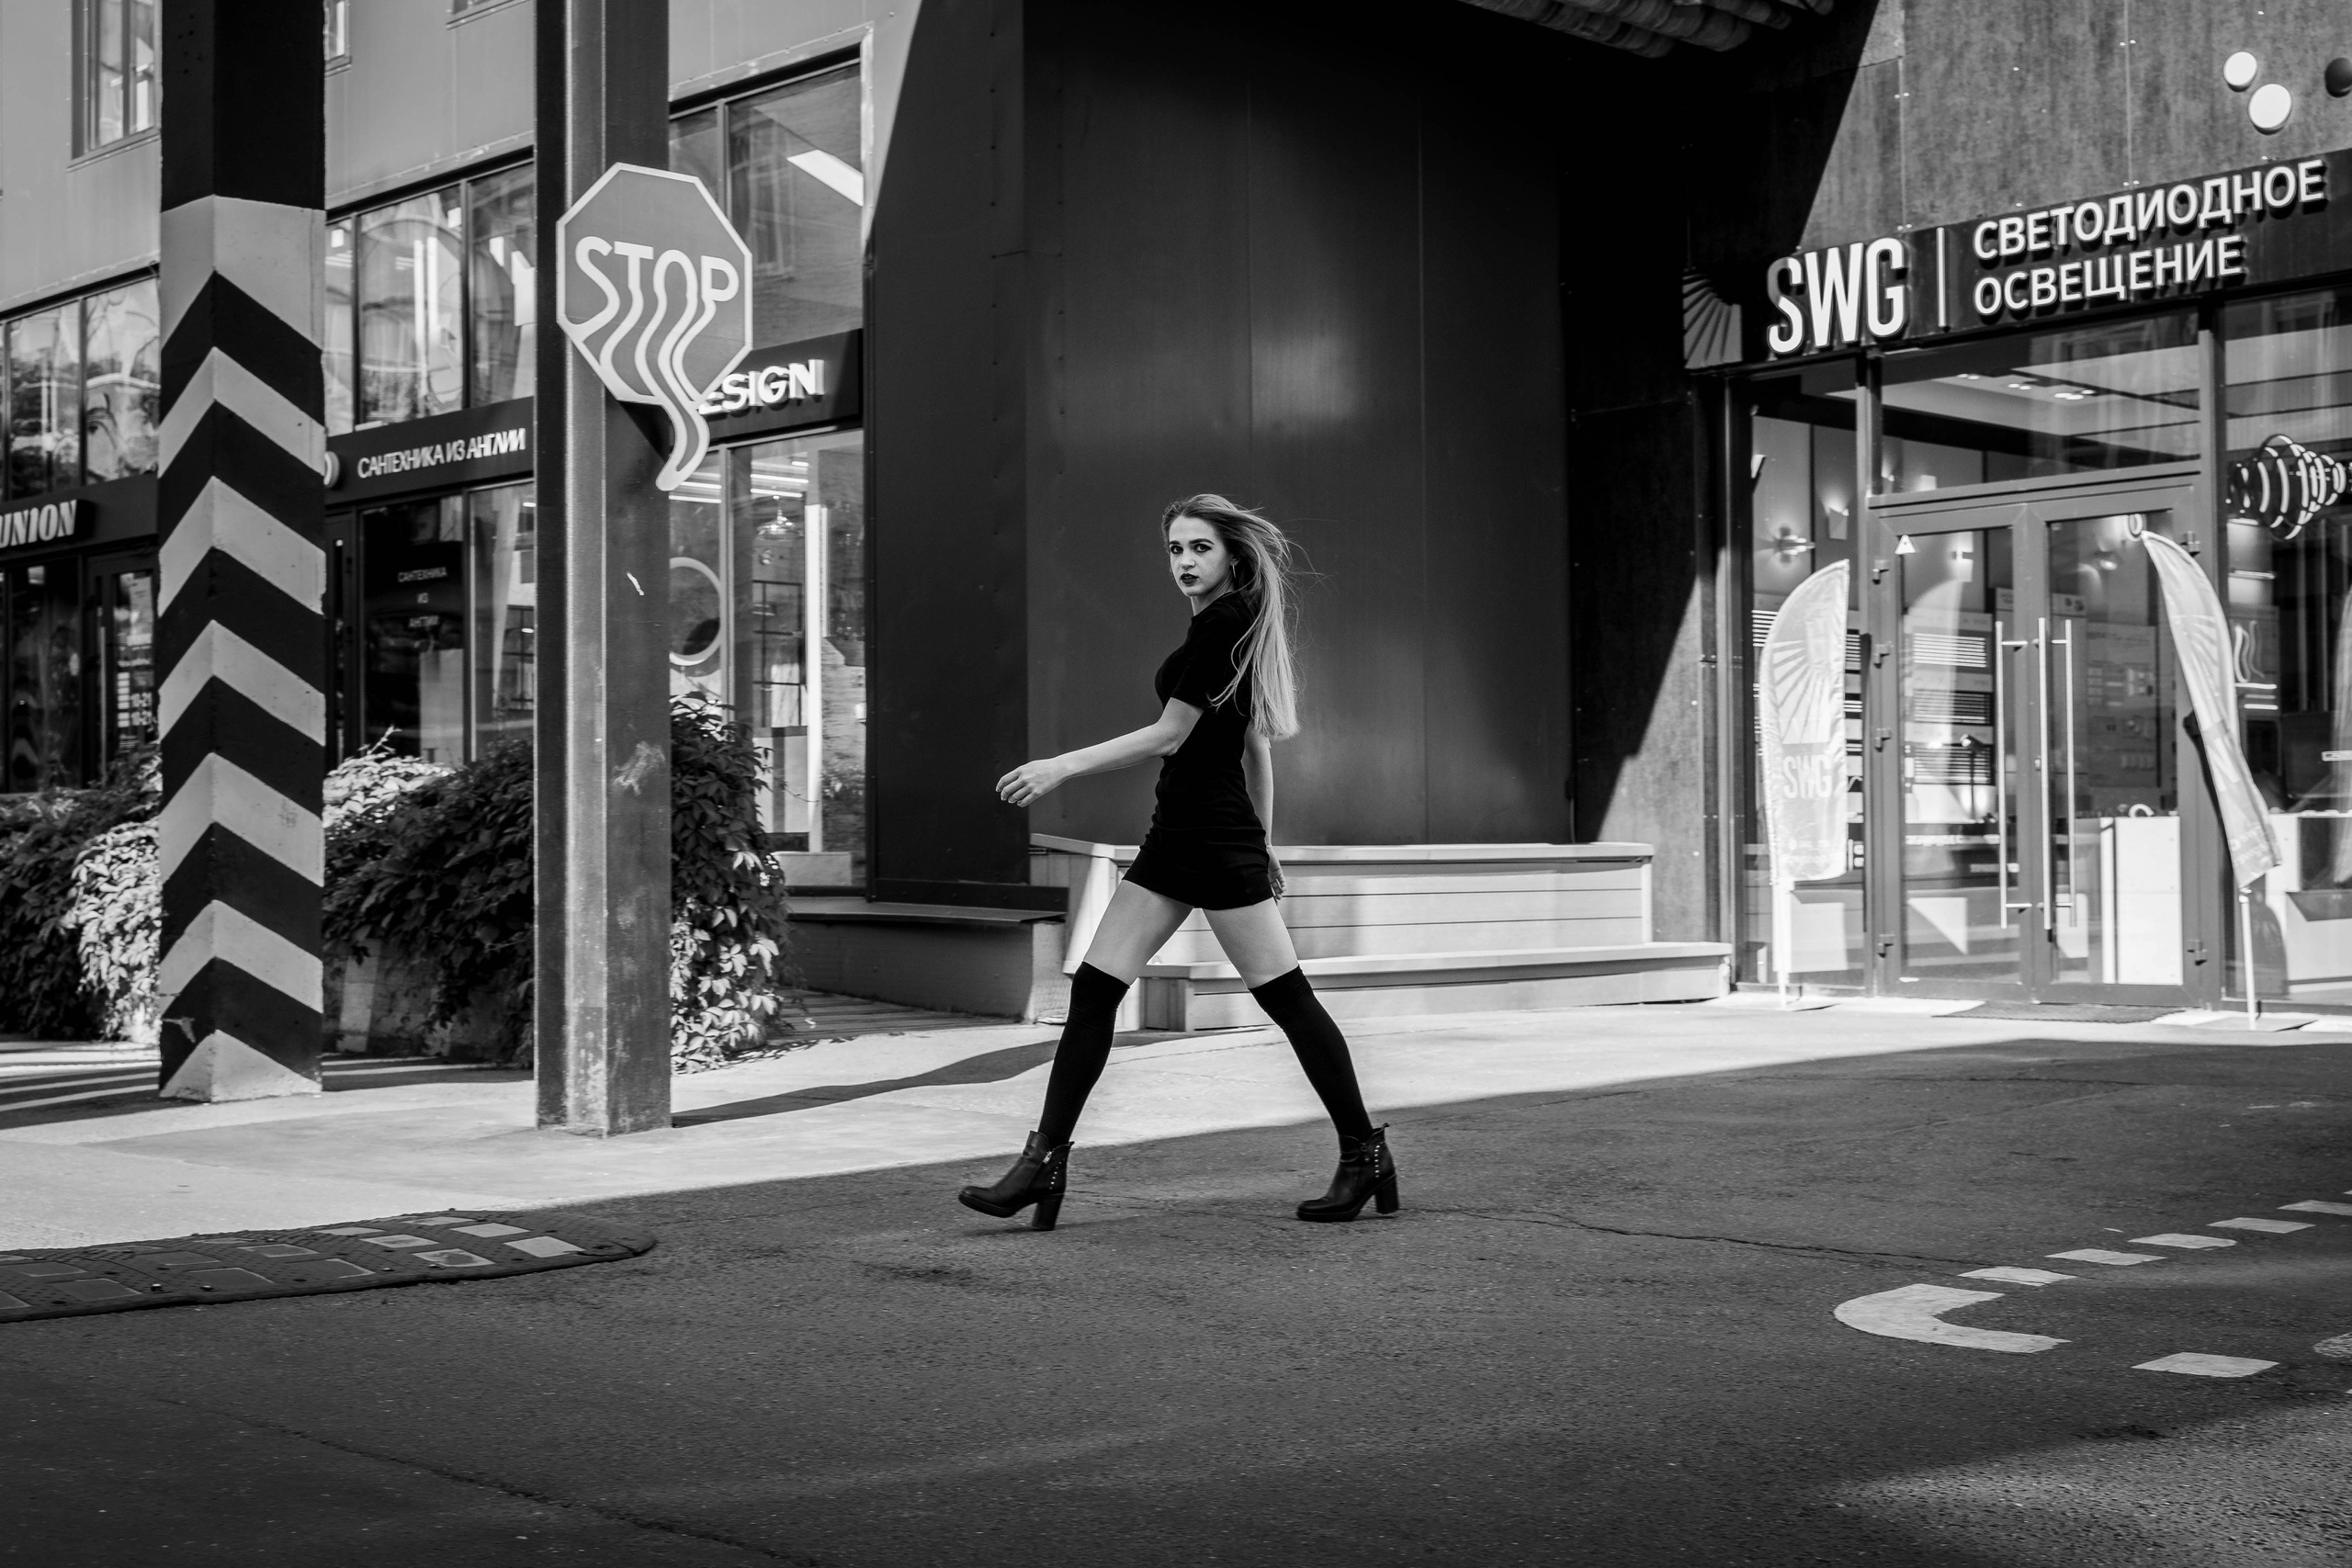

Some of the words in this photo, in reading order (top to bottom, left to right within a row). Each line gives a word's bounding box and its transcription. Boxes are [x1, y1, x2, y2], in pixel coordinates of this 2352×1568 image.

[1973, 159, 2326, 260] СВЕТОДИОДНОЕ
[574, 235, 740, 326] STOP
[1766, 237, 1905, 355] SWG
[1973, 234, 2247, 316] ОСВЕЩЕНИЕ
[356, 443, 446, 479] САНТЕХНИКА
[446, 439, 466, 463] ИЗ
[467, 427, 526, 460] АНГЛИИ
[0, 499, 77, 548] UNION
[1782, 753, 1833, 799] SWG
